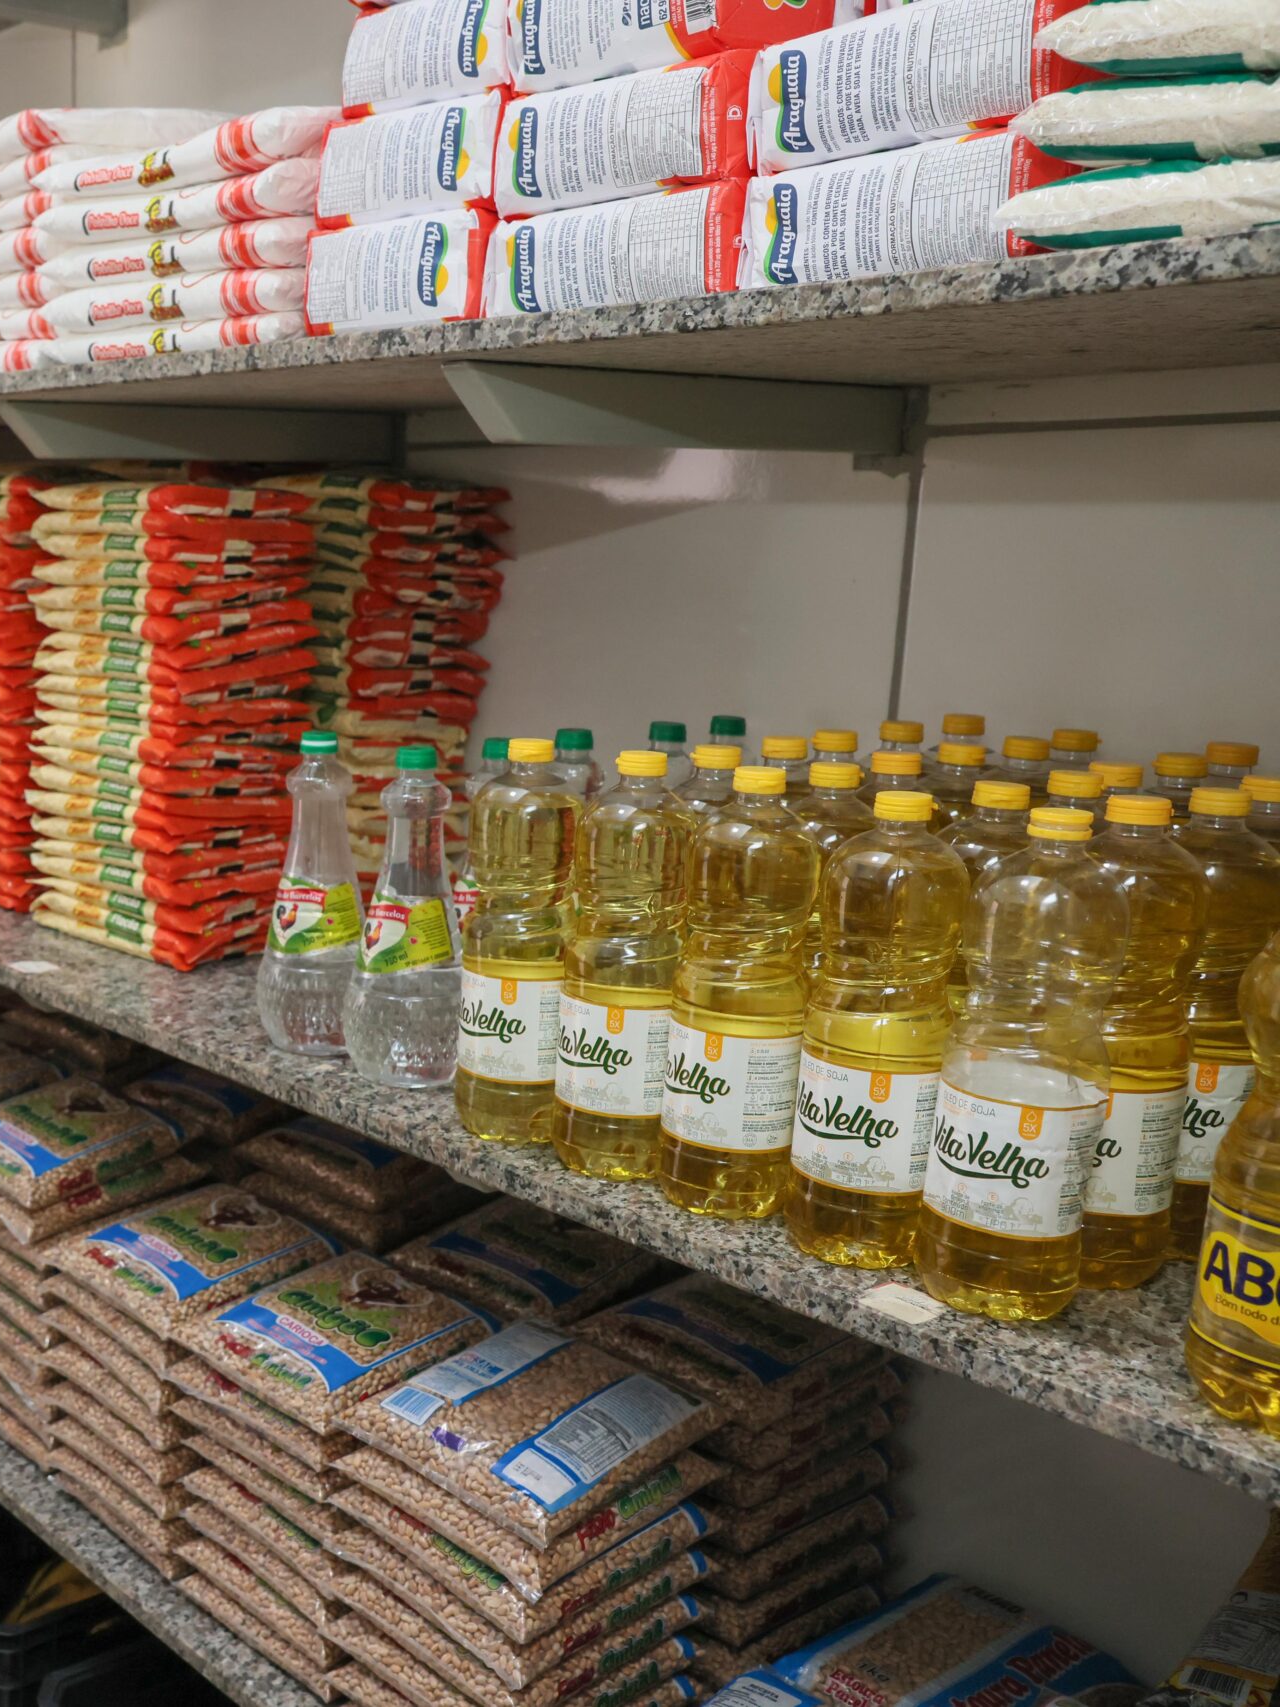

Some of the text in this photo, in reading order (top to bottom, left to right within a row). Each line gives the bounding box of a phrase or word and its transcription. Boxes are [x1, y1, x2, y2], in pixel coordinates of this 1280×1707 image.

[462, 0, 483, 72] Araguaia
[836, 34, 852, 143] ALÉRGICOS: CONTÉM DERIVADOS
[845, 62, 853, 90] CONTER
[906, 20, 919, 122] INFORMAÇÃO NUTRICIONAL
[783, 55, 807, 150] Araguaia
[442, 109, 460, 186] Araguaia
[519, 111, 537, 194] Araguaia
[771, 189, 795, 281] Araguaia
[822, 173, 838, 279] ALÉRGICOS: CONTÉM DERIVADOS
[831, 199, 839, 226] CONTER
[889, 164, 904, 265] INFORMAÇÃO NUTRICIONAL
[421, 224, 441, 301] Araguaia
[517, 228, 536, 310] Araguaia
[471, 1000, 526, 1043] Velha
[610, 1019, 619, 1028] 5X
[573, 1028, 632, 1075] Velha
[708, 1047, 717, 1055] 5X
[827, 1070, 848, 1082] SOJA
[674, 1052, 730, 1104] Velha
[874, 1087, 886, 1096] 5X
[1200, 1077, 1213, 1087] 5X
[824, 1096, 898, 1148] Velha
[970, 1104, 996, 1117] SOJA
[1023, 1123, 1037, 1133] 5X
[934, 1114, 966, 1161] Vila
[968, 1131, 1049, 1189] Velha
[1203, 1240, 1280, 1307] AB
[278, 1316, 326, 1347] CARIOCA
[1240, 1306, 1268, 1322] todo
